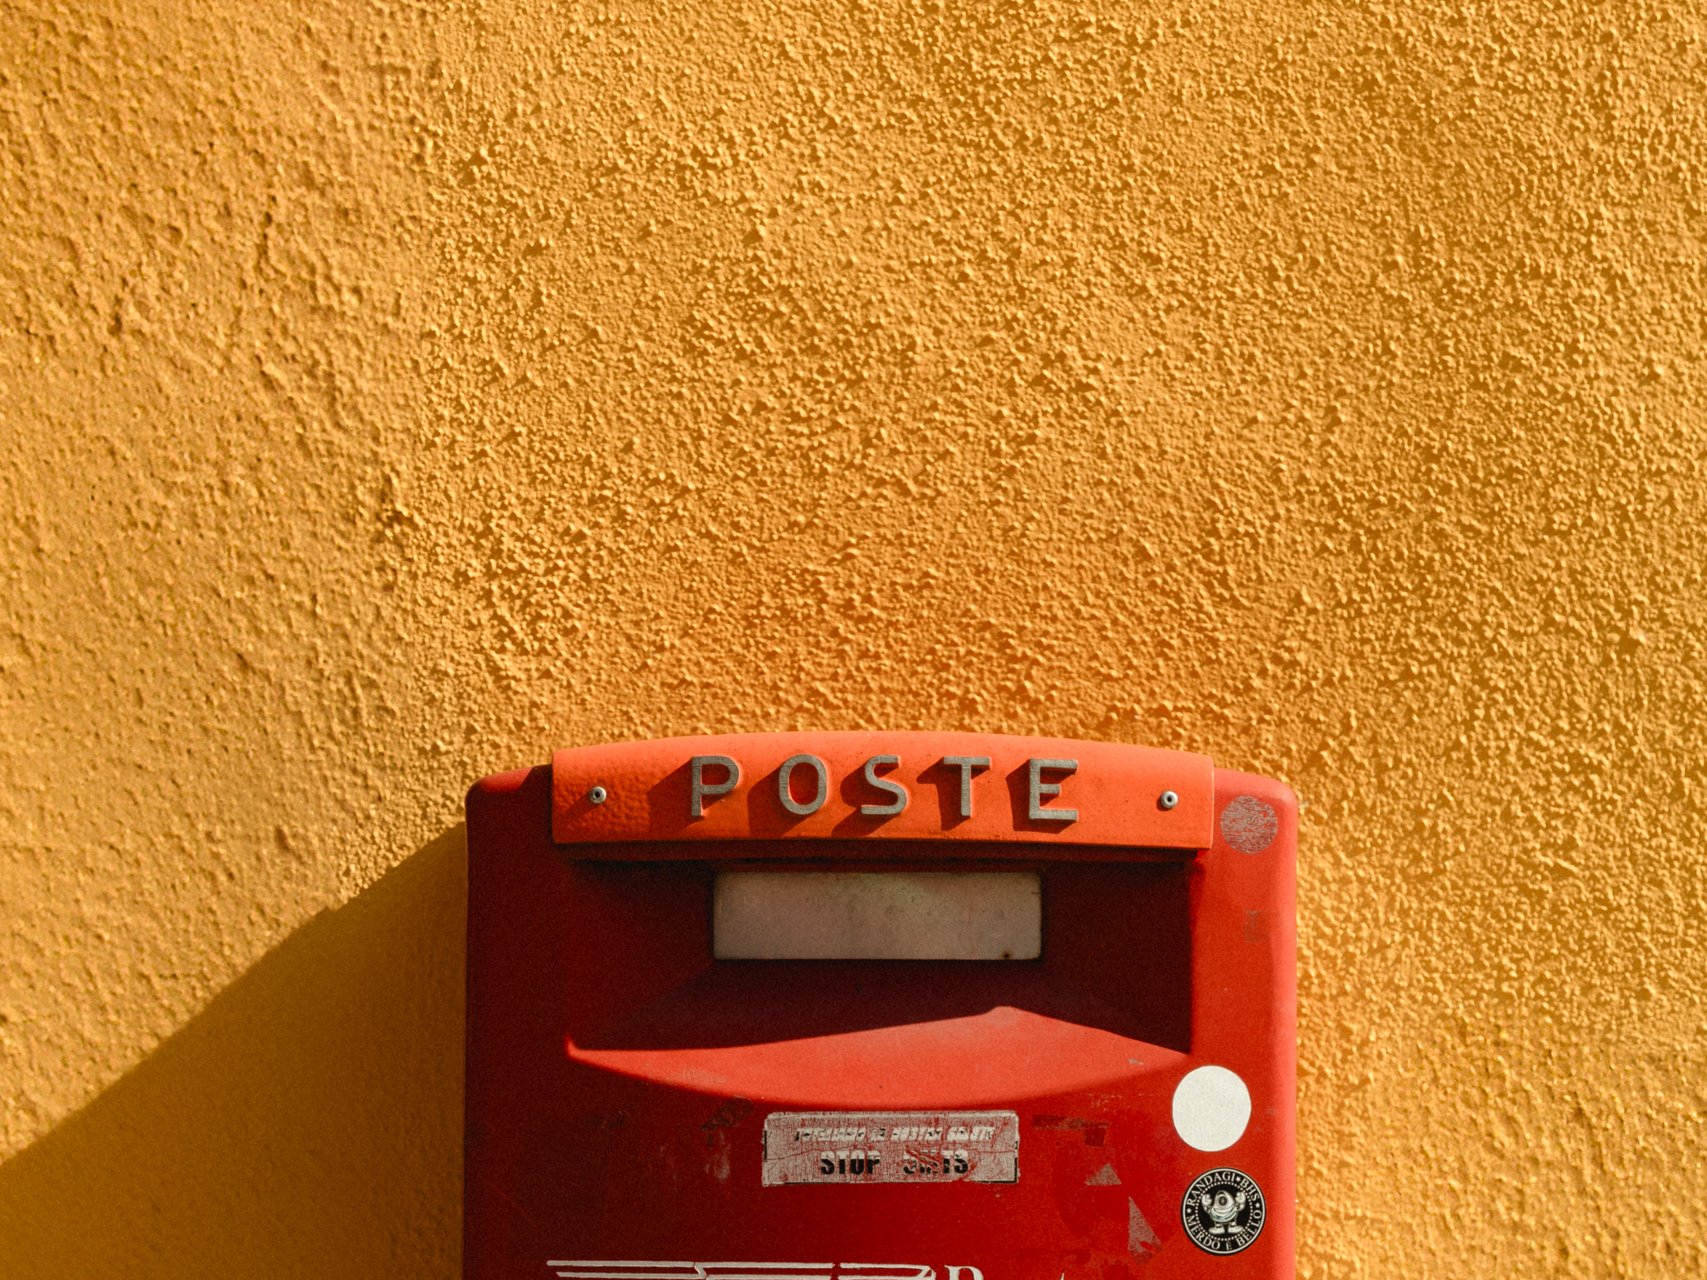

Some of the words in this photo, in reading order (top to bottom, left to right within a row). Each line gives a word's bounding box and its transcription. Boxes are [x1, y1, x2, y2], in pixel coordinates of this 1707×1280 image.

[690, 753, 1079, 822] POSTE
[820, 1150, 881, 1175] STOP
[1187, 1171, 1236, 1206] RANDAGI
[1240, 1178, 1260, 1201] BHS
[1186, 1214, 1221, 1250] MERDO
[1236, 1210, 1262, 1247] BELLO
